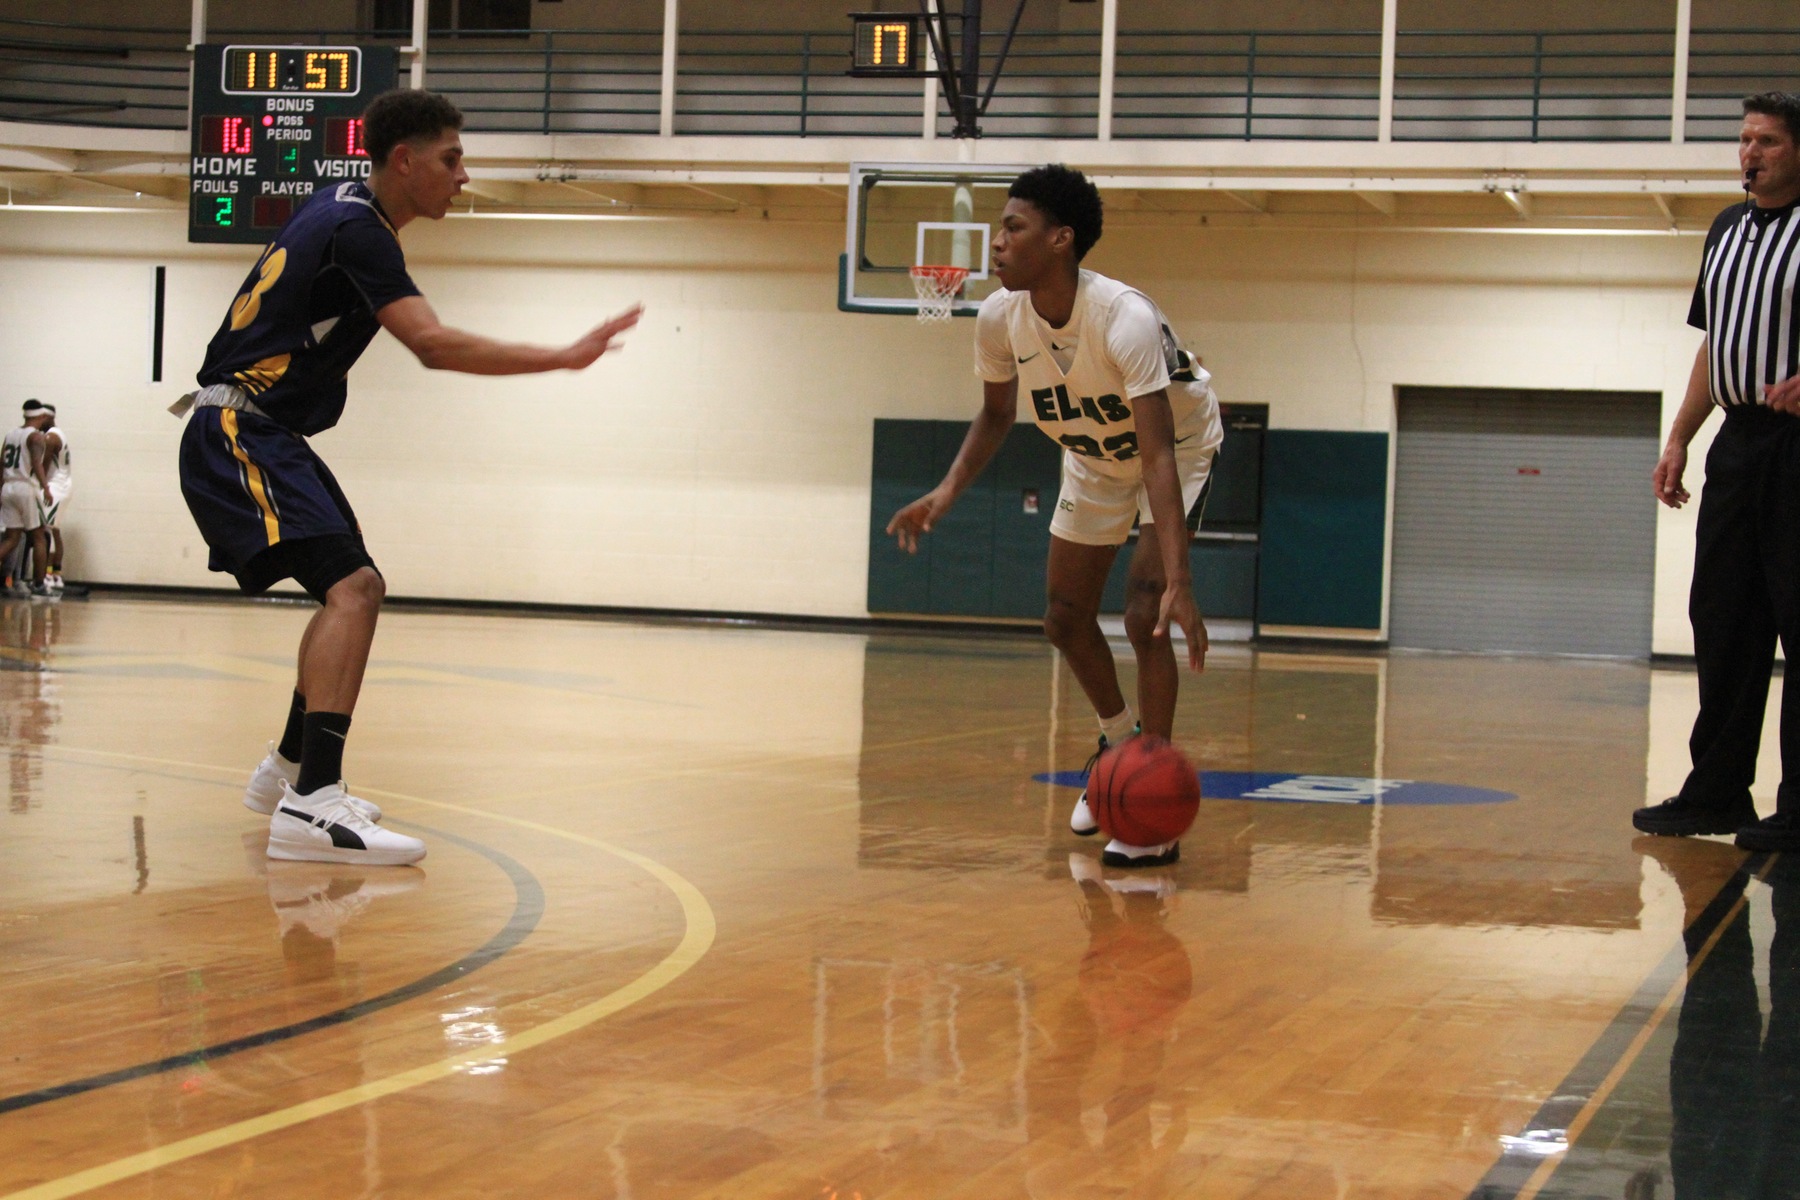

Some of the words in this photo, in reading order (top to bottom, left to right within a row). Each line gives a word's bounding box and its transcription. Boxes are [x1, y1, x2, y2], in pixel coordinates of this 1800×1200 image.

[874, 25, 906, 64] 17
[266, 98, 315, 112] BONUS
[277, 116, 304, 126] POSS
[223, 117, 251, 153] 10
[266, 129, 312, 141] PERIOD
[193, 157, 257, 175] HOME
[314, 159, 372, 178] VISITO
[193, 179, 239, 194] FOULS
[261, 181, 314, 195] PLAYER
[216, 197, 232, 226] 2
[230, 241, 288, 331] 3
[4, 443, 21, 469] 31
